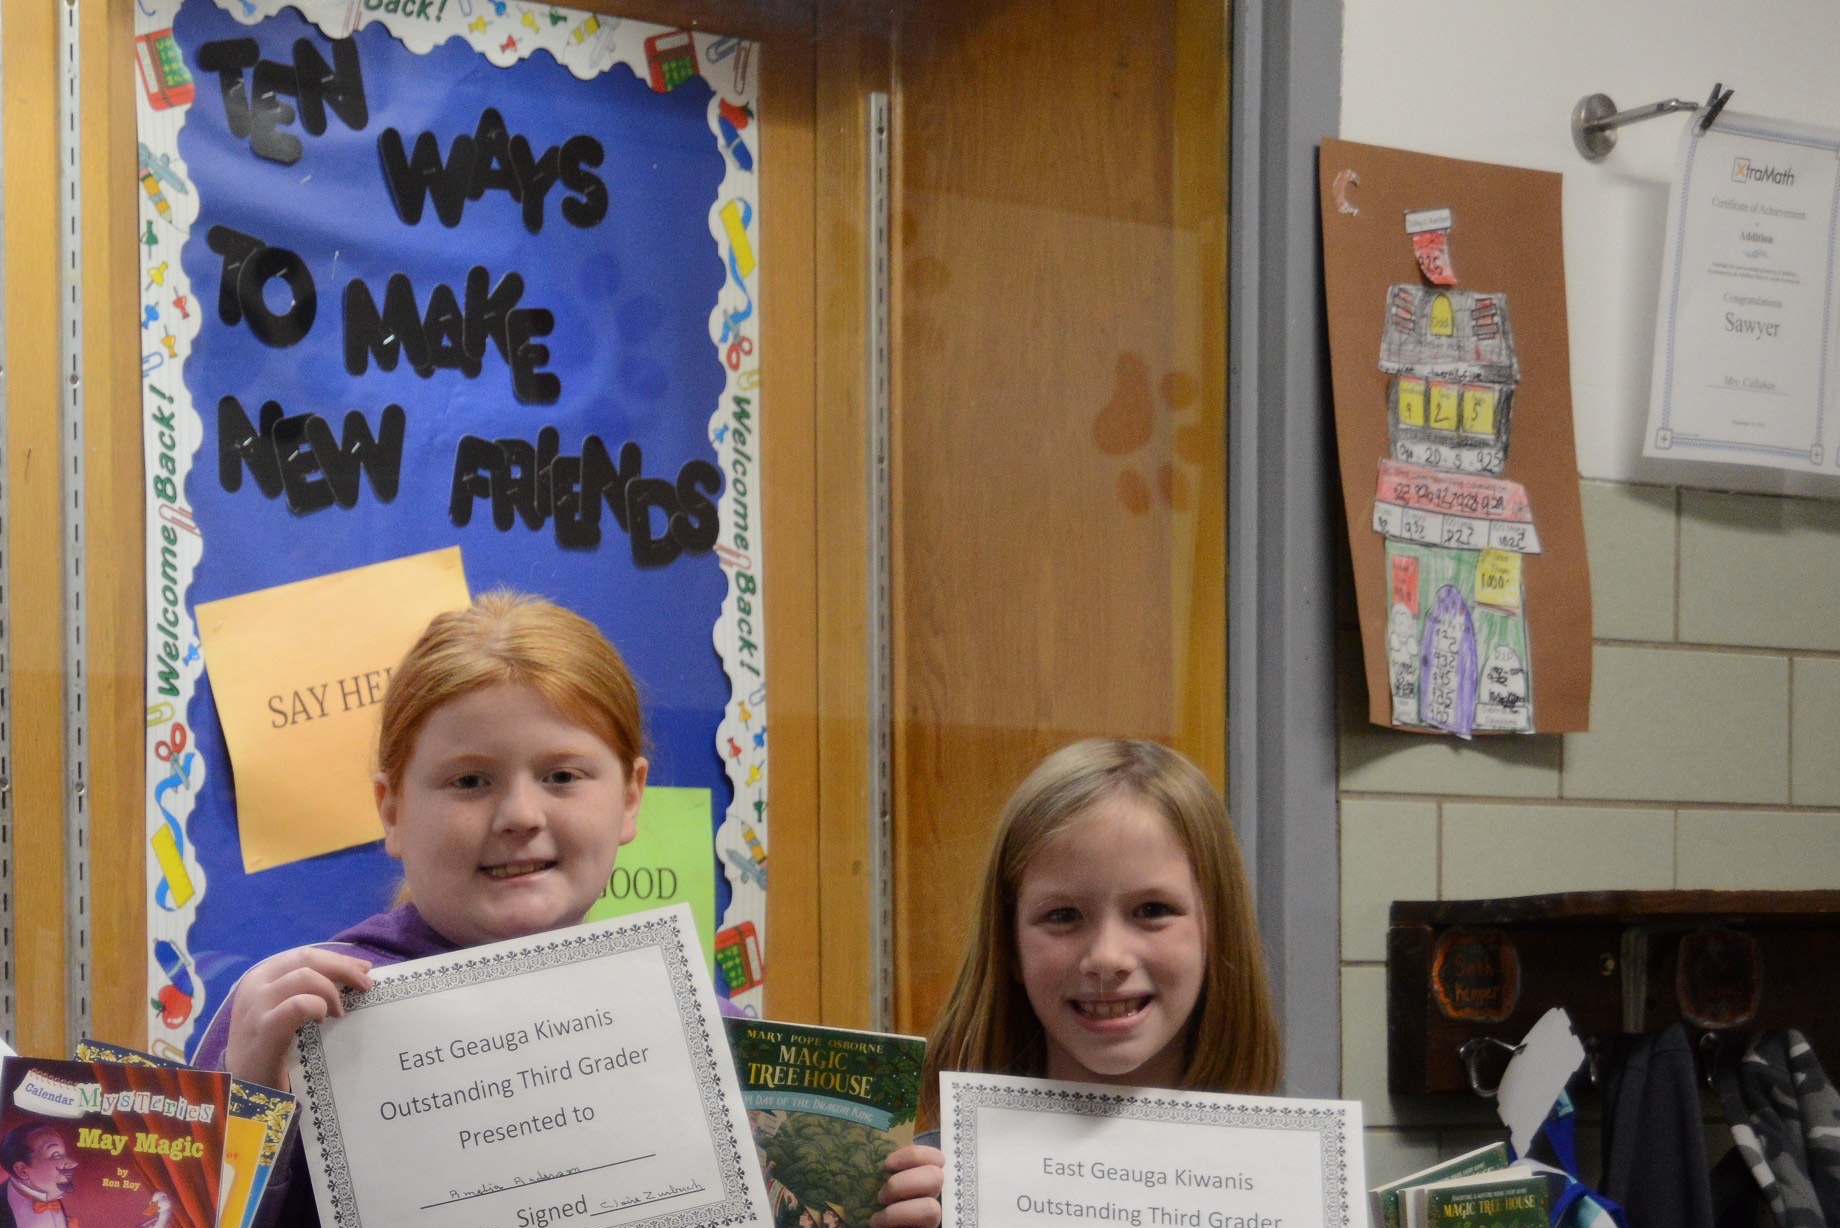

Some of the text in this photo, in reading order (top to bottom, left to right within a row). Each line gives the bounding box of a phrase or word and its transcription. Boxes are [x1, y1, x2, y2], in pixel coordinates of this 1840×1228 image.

[196, 36, 368, 166] TEN
[378, 107, 609, 233] WAYS
[1733, 160, 1796, 187] XtraMath
[205, 224, 561, 404] TO MAKE
[1725, 311, 1781, 340] Sawyer
[216, 395, 721, 570] NEW FRIENDS
[148, 384, 180, 697] Welcome Back!
[731, 394, 760, 677] Welcome Back!
[268, 683, 329, 728] SAY
[599, 867, 677, 899] OOD
[398, 1007, 614, 1072] East Geauga Kiwanis
[747, 1029, 885, 1054] MARY POPE OSBORNE
[779, 1045, 849, 1071] MAGIC
[24, 1083, 74, 1107] Calendar
[380, 1045, 650, 1122] Outstanding Third Grader
[748, 1062, 873, 1099] TREE HOUSE
[459, 1103, 595, 1150] Presented to
[77, 1127, 204, 1161] May Magic
[102, 1178, 141, 1192] Ron Roy
[117, 1167, 128, 1178] by
[1043, 1157, 1254, 1191] East Geauga Kiwanis
[516, 1197, 588, 1228] Signed
[1017, 1195, 1141, 1227] Outstanding
[1148, 1206, 1200, 1228] Third
[1443, 1200, 1476, 1219] MAGIC
[1479, 1198, 1501, 1217] TREE
[1505, 1194, 1536, 1211] HOUSE
